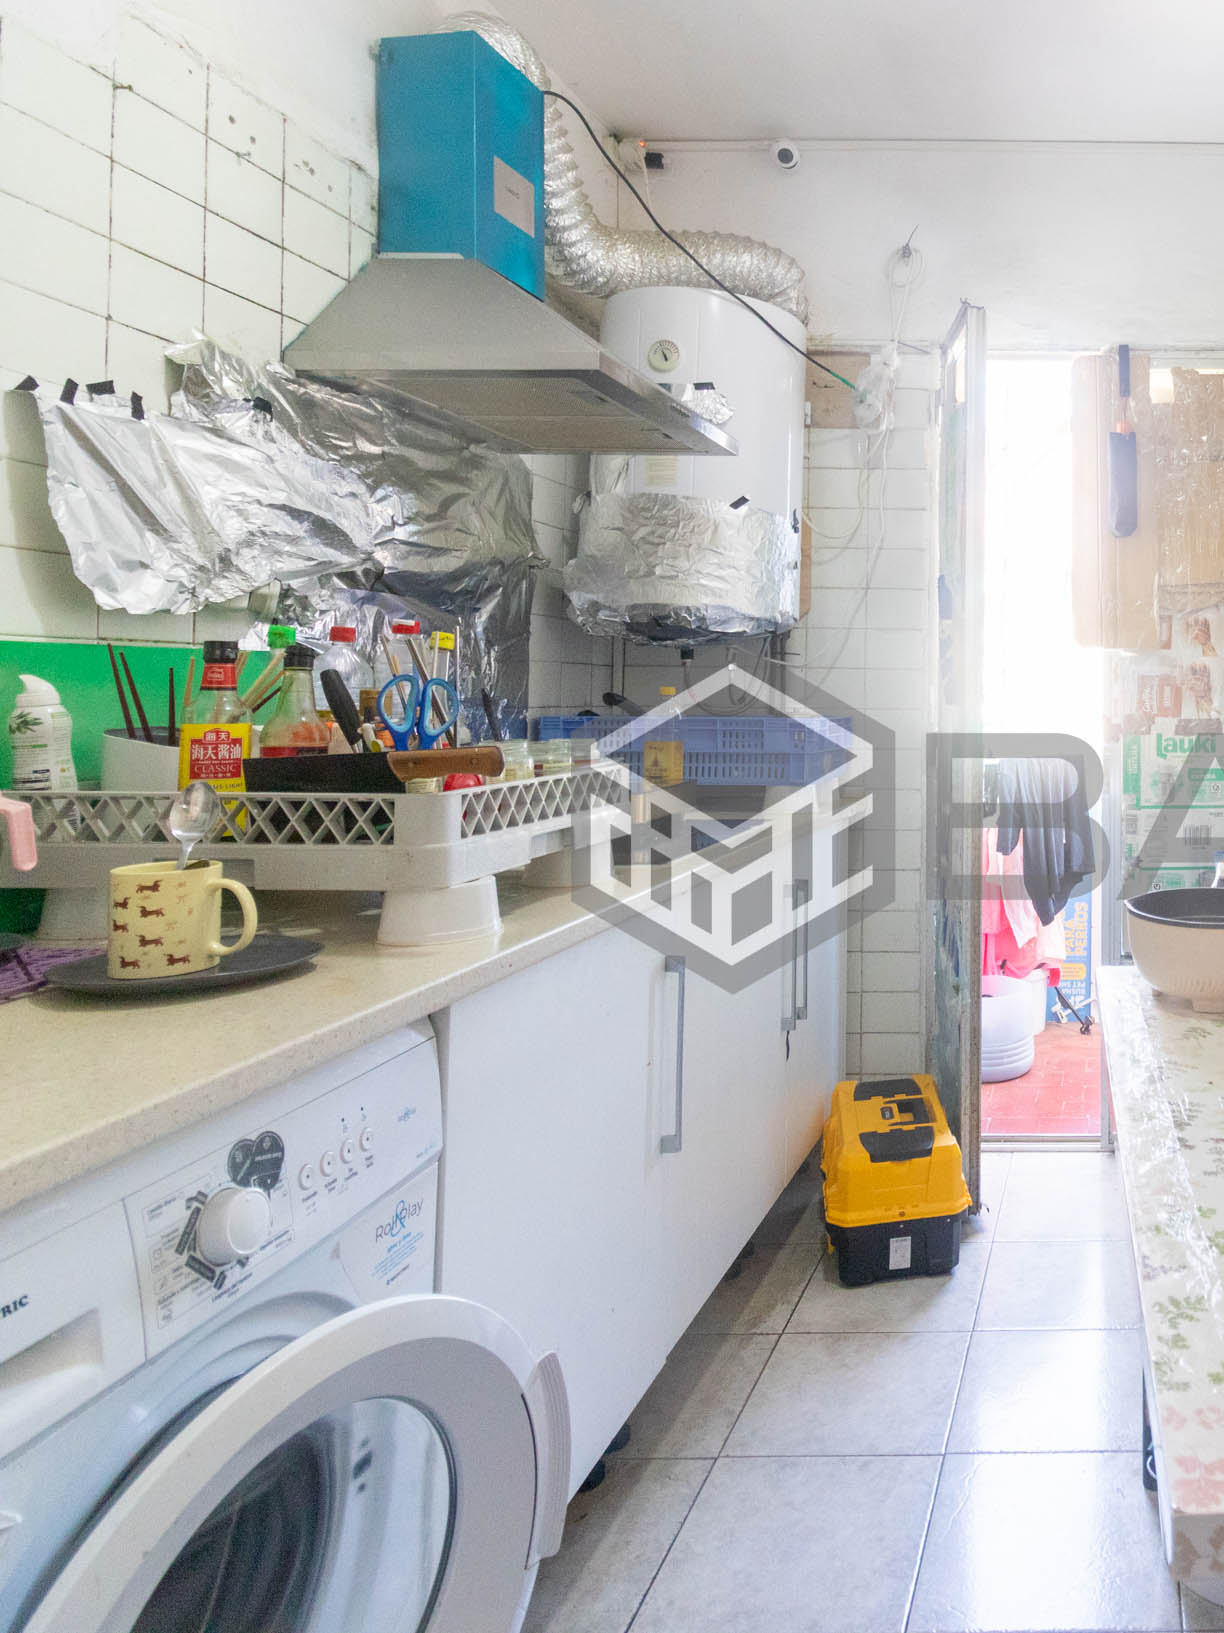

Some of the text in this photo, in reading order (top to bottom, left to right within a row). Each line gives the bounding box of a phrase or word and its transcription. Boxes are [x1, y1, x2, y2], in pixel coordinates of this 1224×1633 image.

[1156, 733, 1216, 759] lauki
[194, 764, 237, 773] CLASSIC
[1075, 902, 1089, 957] PERROS
